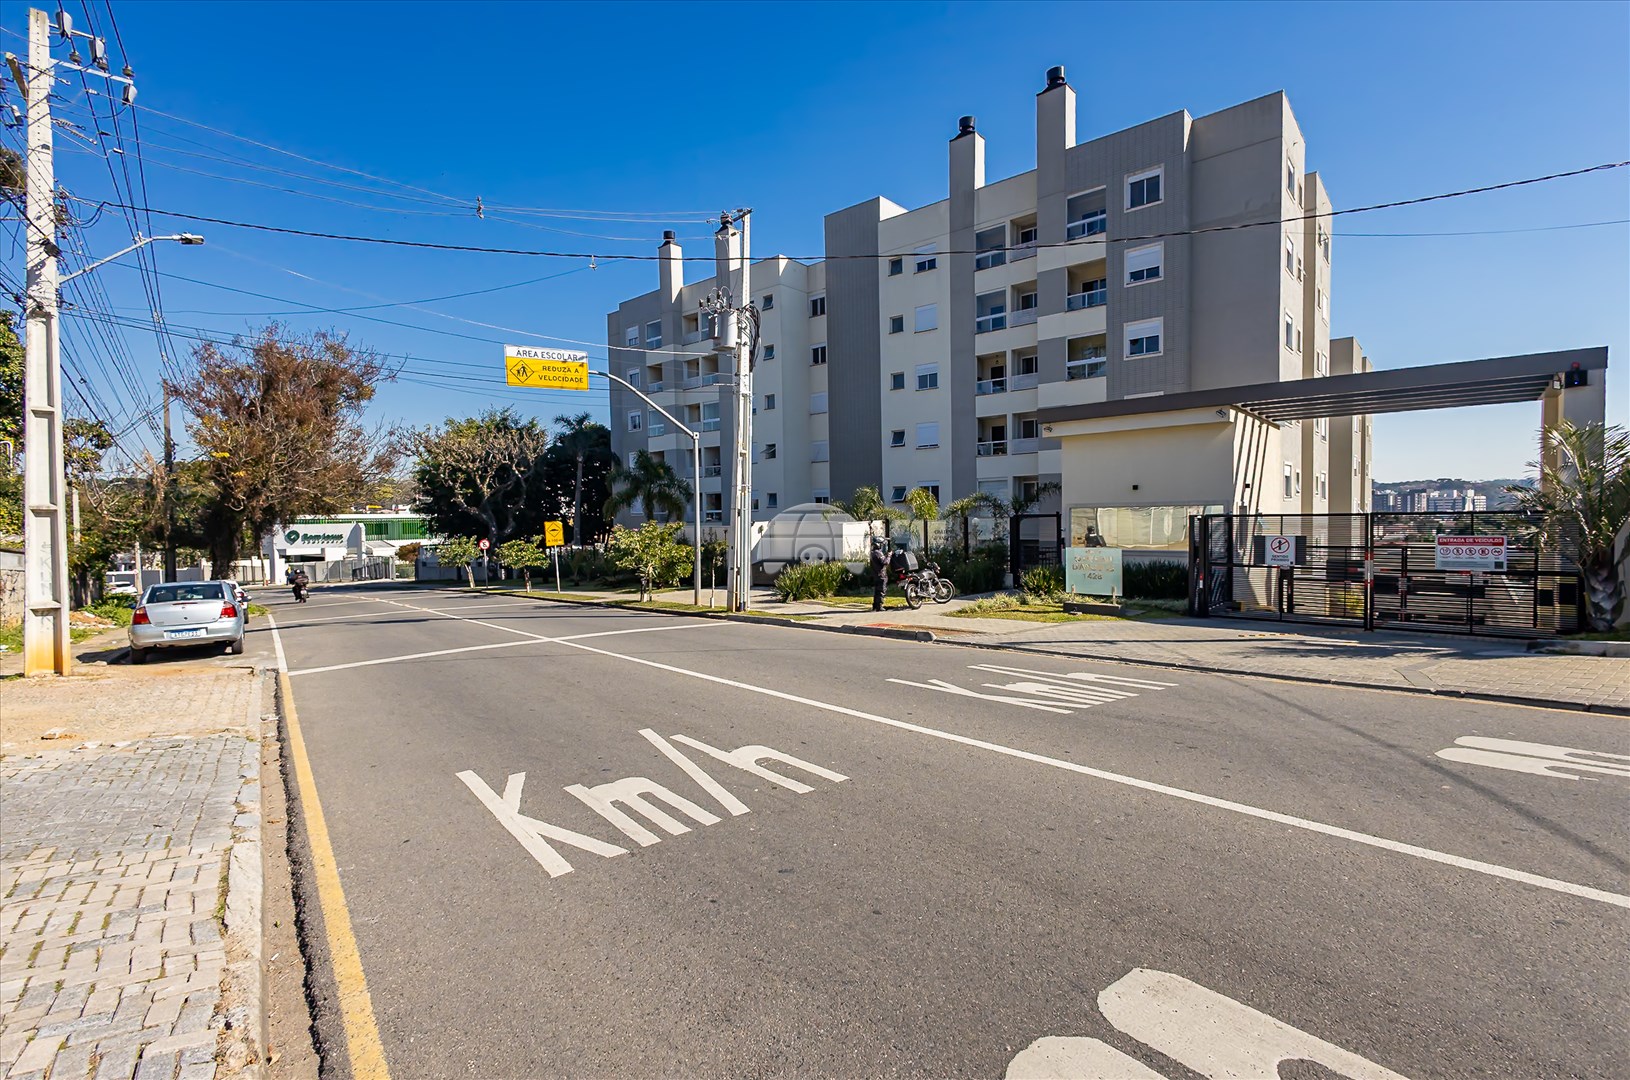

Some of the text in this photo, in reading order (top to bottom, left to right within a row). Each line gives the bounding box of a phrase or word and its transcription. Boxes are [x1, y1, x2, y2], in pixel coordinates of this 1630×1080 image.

[541, 351, 578, 361] ESCOLAR
[542, 365, 572, 373] REDUZA
[538, 374, 584, 383] VELOCIDADE
[455, 728, 850, 878] Km/h
